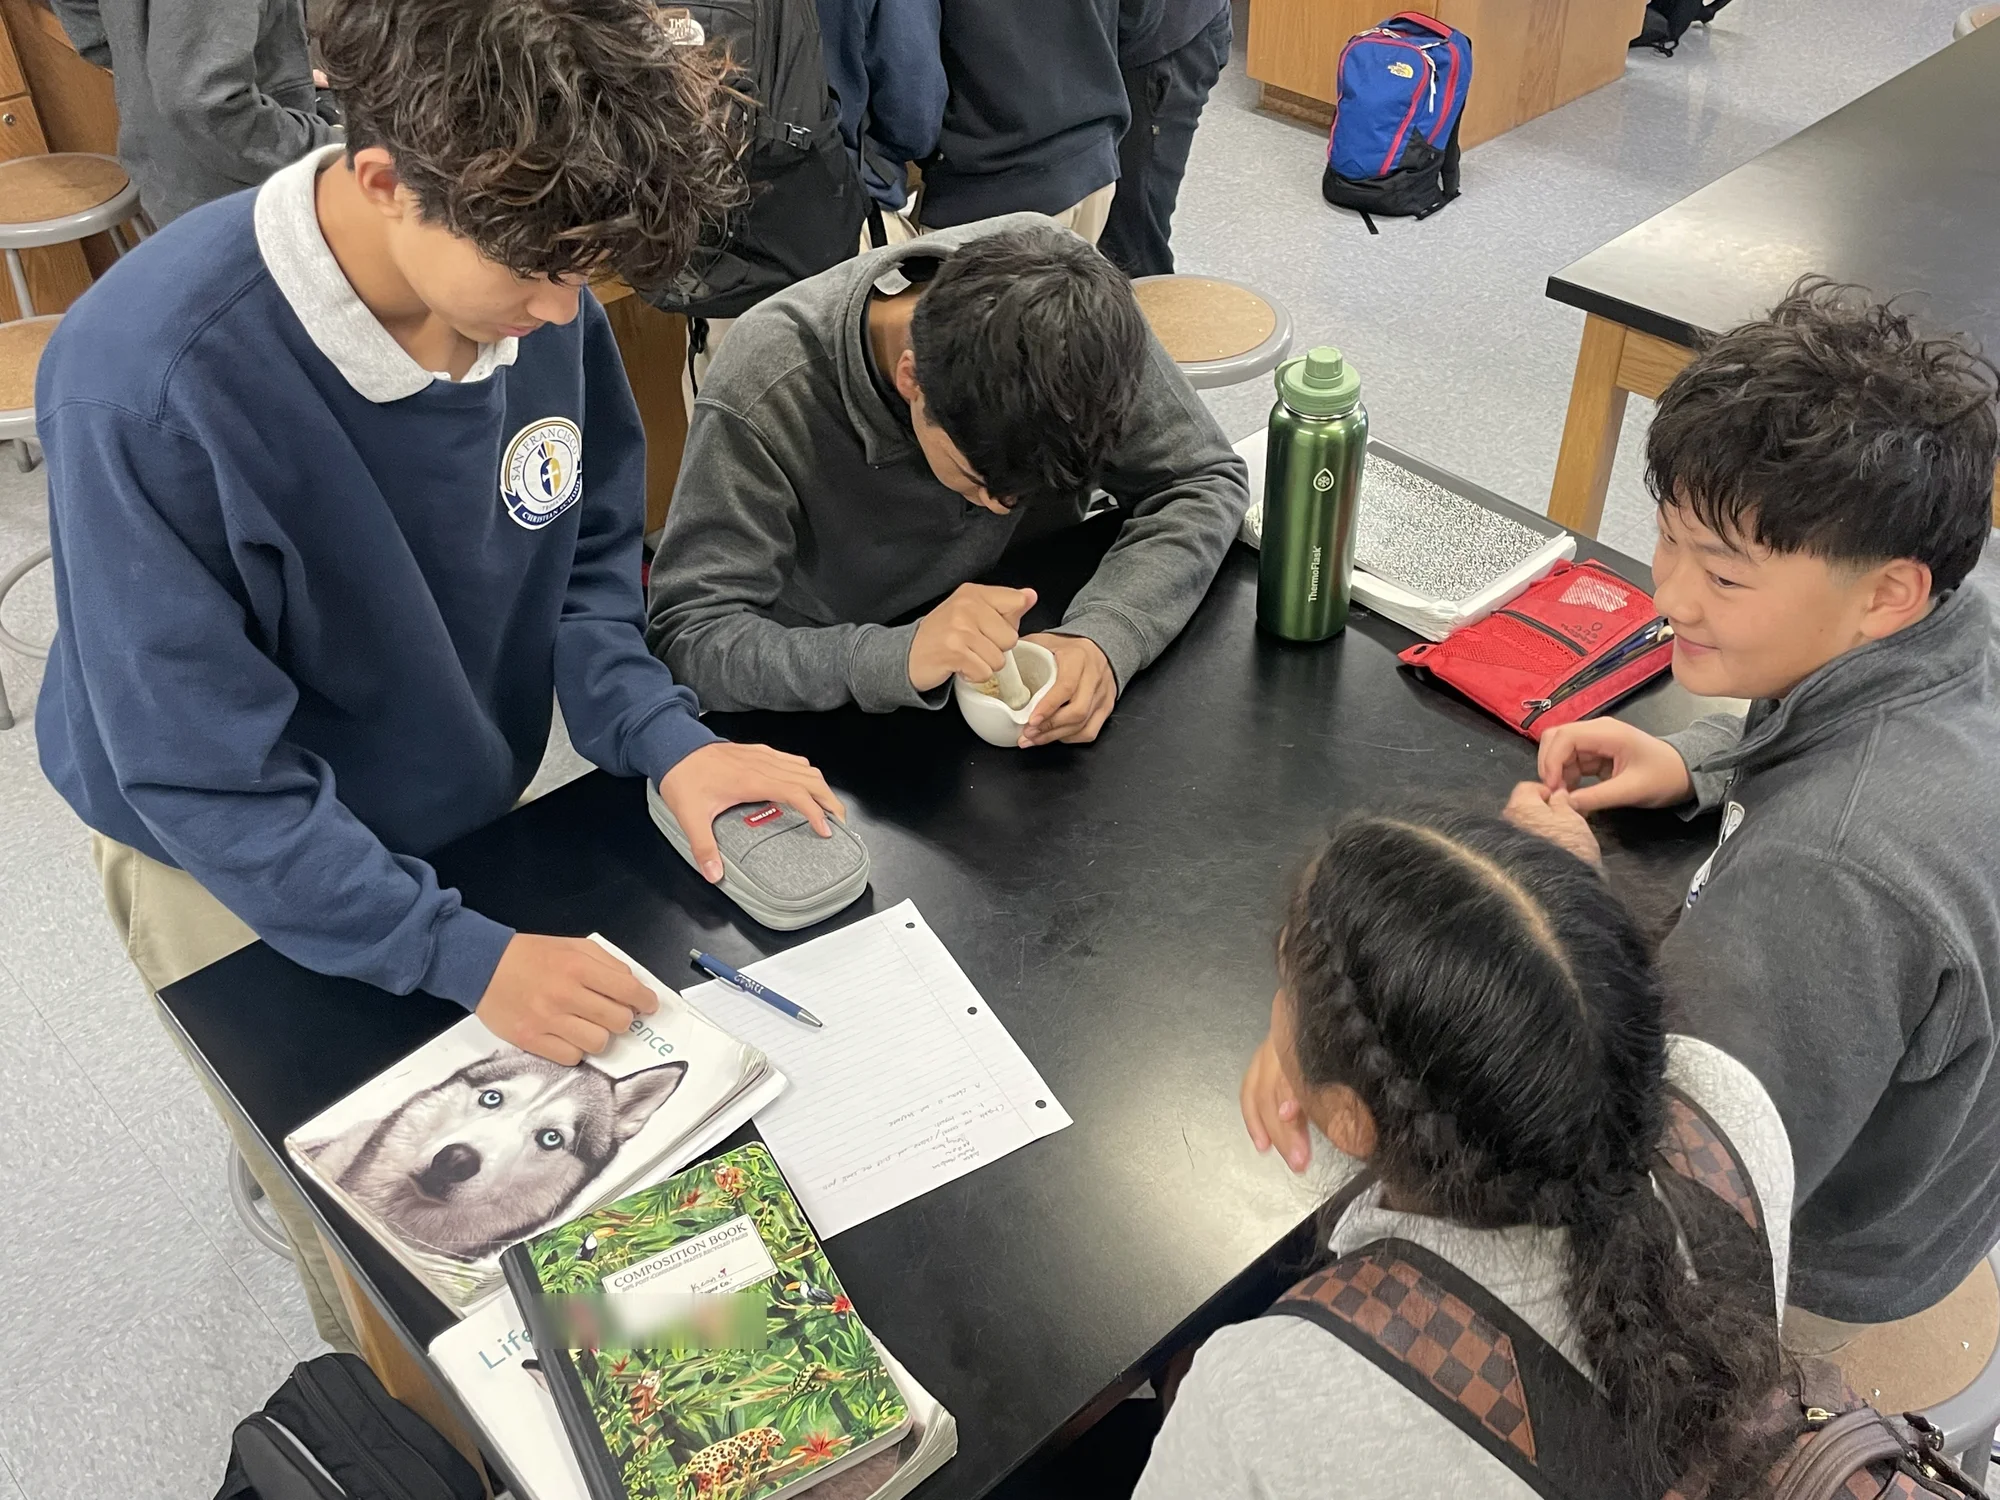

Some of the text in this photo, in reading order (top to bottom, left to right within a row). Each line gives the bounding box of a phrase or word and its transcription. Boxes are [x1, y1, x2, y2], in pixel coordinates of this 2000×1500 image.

[511, 428, 578, 481] SAN FRANCISCO
[522, 509, 559, 523] CHRISTIAN
[1308, 545, 1321, 602] ThermoFlask
[629, 1020, 674, 1057] ence
[614, 1239, 707, 1288] COMPOSITION
[708, 1222, 748, 1246] BOOK
[478, 1329, 532, 1369] Life
